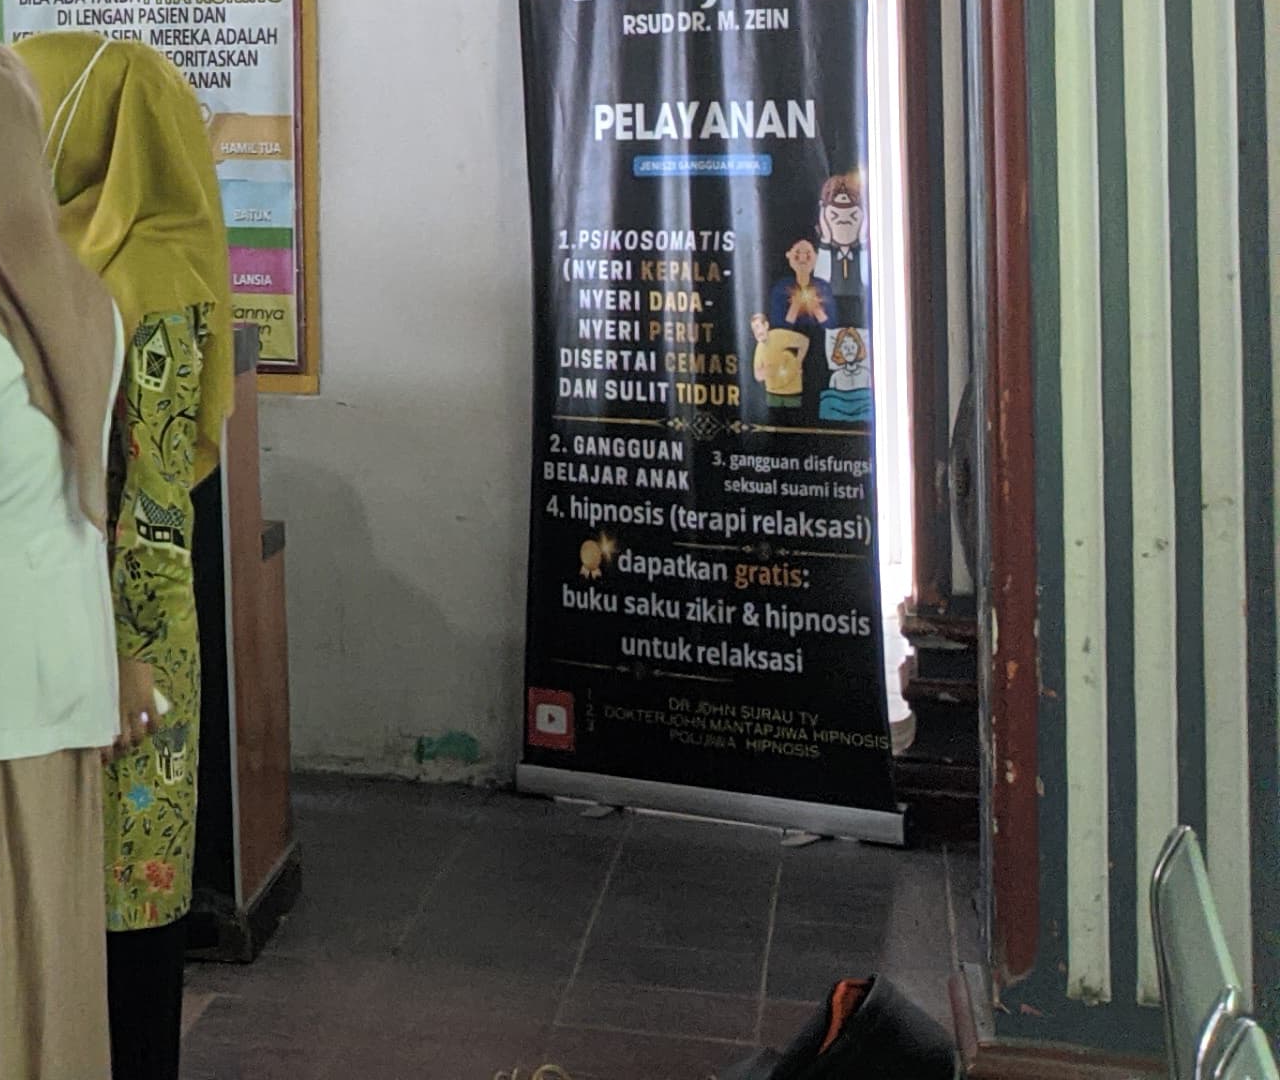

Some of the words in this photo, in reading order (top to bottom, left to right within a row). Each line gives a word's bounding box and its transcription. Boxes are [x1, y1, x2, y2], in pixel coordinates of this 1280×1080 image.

[57, 9, 72, 26] DI
[77, 8, 134, 25] LENGAN
[138, 7, 188, 24] PASIEN
[193, 7, 226, 24] DAN
[623, 13, 674, 35] RSUD
[678, 12, 711, 32] DR.
[718, 10, 739, 30] M.
[744, 8, 789, 30] ZEIN
[150, 28, 210, 46] MEREKA
[215, 27, 278, 45] ADALAH
[594, 100, 816, 141] PELAYANAN
[221, 142, 257, 155] HAMIL
[260, 141, 281, 155] TUA
[233, 273, 272, 287] LANSIA
[563, 258, 632, 282] (NYERI
[641, 260, 731, 282] KEPALA-
[579, 289, 640, 311] NYERI
[649, 291, 713, 312] DADA-
[578, 319, 640, 341] NYERI
[649, 322, 714, 344] PERUT
[560, 348, 656, 372] DISERTAI
[665, 352, 738, 375] CEMAS
[559, 377, 597, 399] DAN
[604, 379, 669, 403] SULIT
[676, 383, 740, 406] TIDUR
[549, 433, 568, 454] 2.
[573, 435, 684, 462] GANGGUAN
[543, 461, 629, 487] BELAJAR
[635, 468, 690, 491] ANAK
[711, 451, 726, 466] 3.
[729, 453, 800, 474] gangguan
[804, 454, 873, 477] disfungsi
[724, 477, 777, 495] seksual
[780, 482, 829, 498] suami
[833, 482, 865, 500] istri
[545, 494, 565, 518] 4.
[570, 495, 664, 528] hipnosis
[670, 504, 746, 539] (terapi
[752, 510, 872, 546] relaksasi)
[617, 549, 728, 583] dapatkan
[734, 563, 811, 590] gratis:
[562, 583, 617, 614] buku
[623, 591, 680, 619] saku
[686, 597, 737, 625] zikir
[741, 601, 760, 628] &
[765, 602, 872, 638] hipnosis
[621, 635, 693, 663] untuk
[696, 640, 803, 674] relaksasi
[695, 700, 737, 718] JOHN
[740, 704, 794, 723] SURAU
[746, 737, 822, 758] HIPNOSIS
[813, 724, 890, 750] HIPNOSIS
